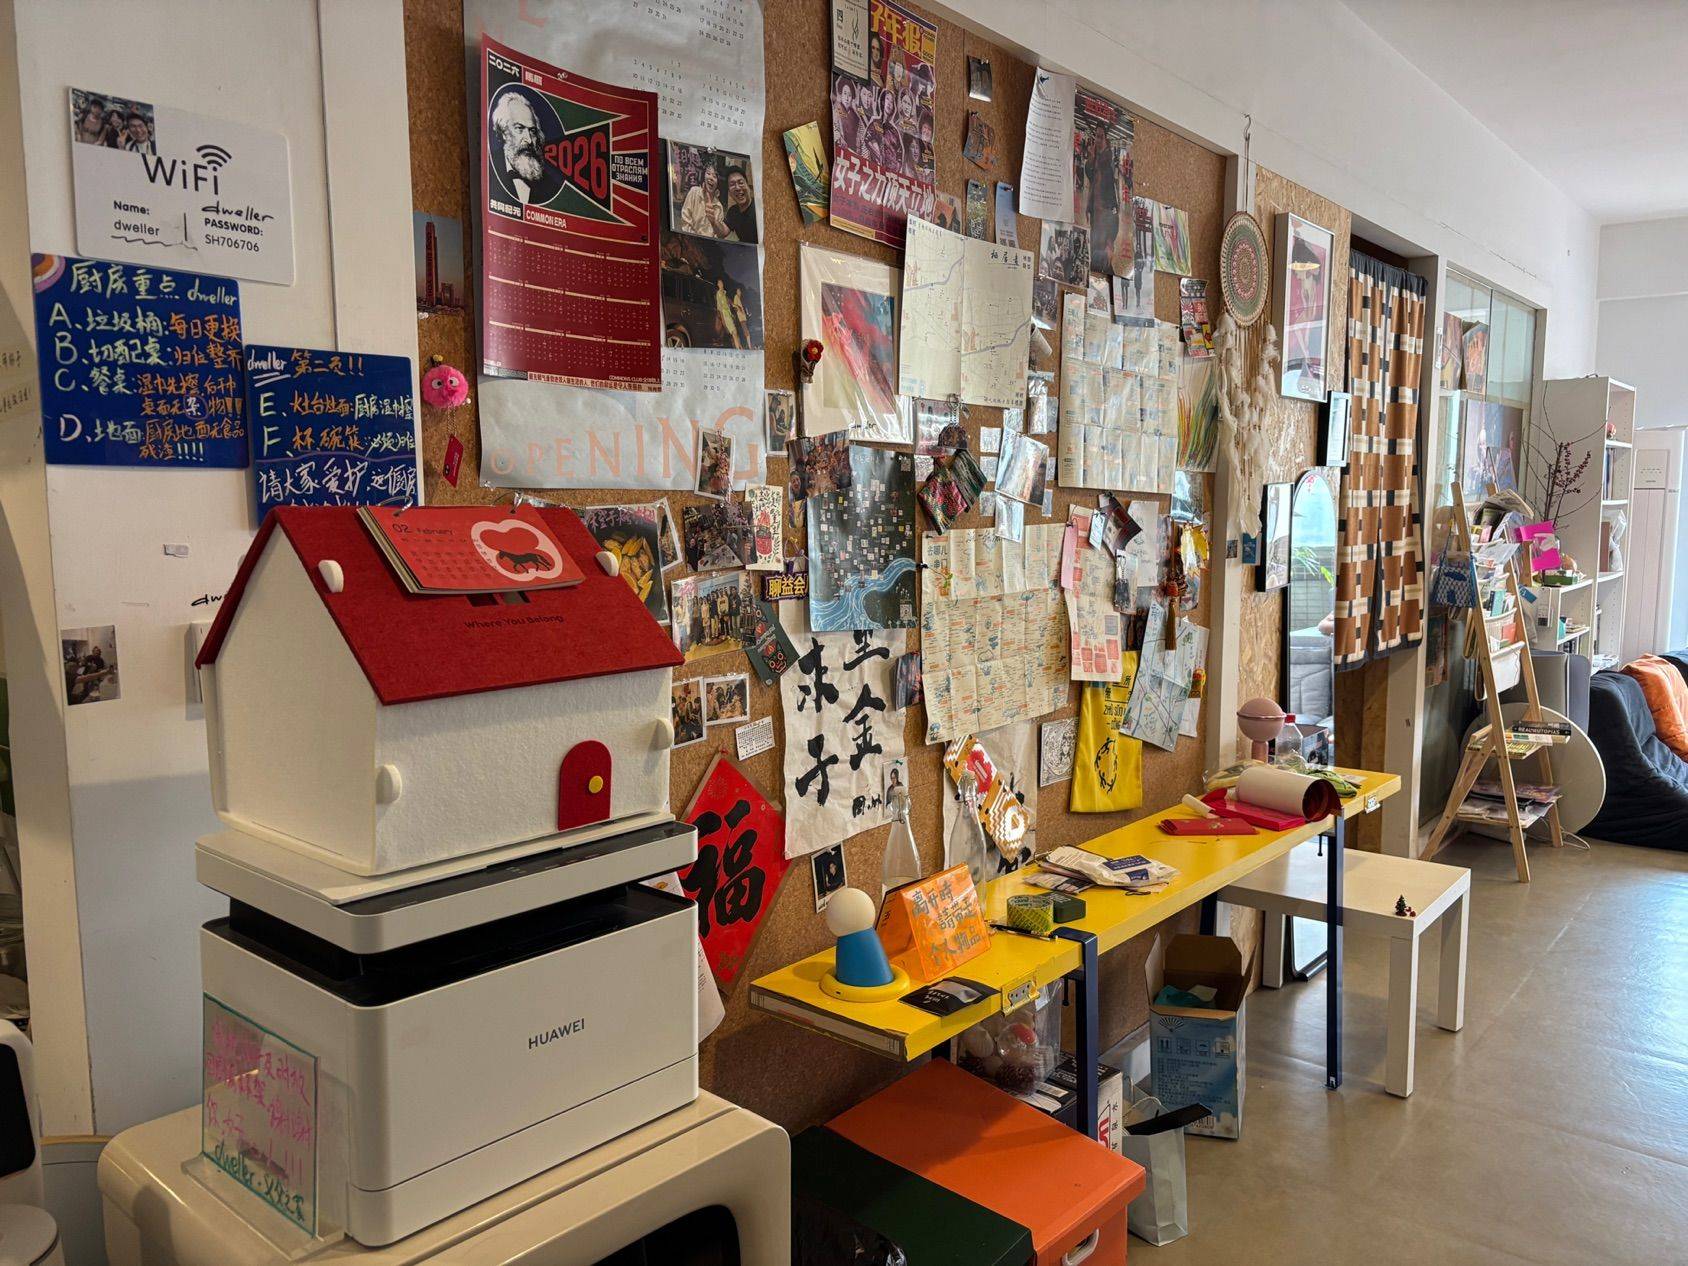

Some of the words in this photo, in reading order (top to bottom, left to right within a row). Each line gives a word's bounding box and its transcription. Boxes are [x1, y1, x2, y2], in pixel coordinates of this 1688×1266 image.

[545, 131, 607, 200] 2026
[614, 154, 624, 165] ПО
[625, 154, 645, 167] ВСЕМ
[141, 152, 220, 196] WiFi
[615, 171, 643, 183] ЗНАНИЯ
[113, 199, 150, 216] Name:
[201, 201, 275, 223] dweller
[113, 219, 161, 237] dweller
[204, 217, 264, 236] PASSWORD:
[526, 209, 554, 226] COMMON
[555, 216, 568, 229] ERA
[204, 234, 260, 253] SH706706
[70, 260, 180, 300] 厨房重点
[187, 277, 237, 306] dweller
[490, 406, 759, 480] OPENING
[464, 618, 502, 629] Where
[502, 616, 527, 626] You
[527, 614, 565, 624] Belong
[528, 1017, 585, 1050] HUAWEI
